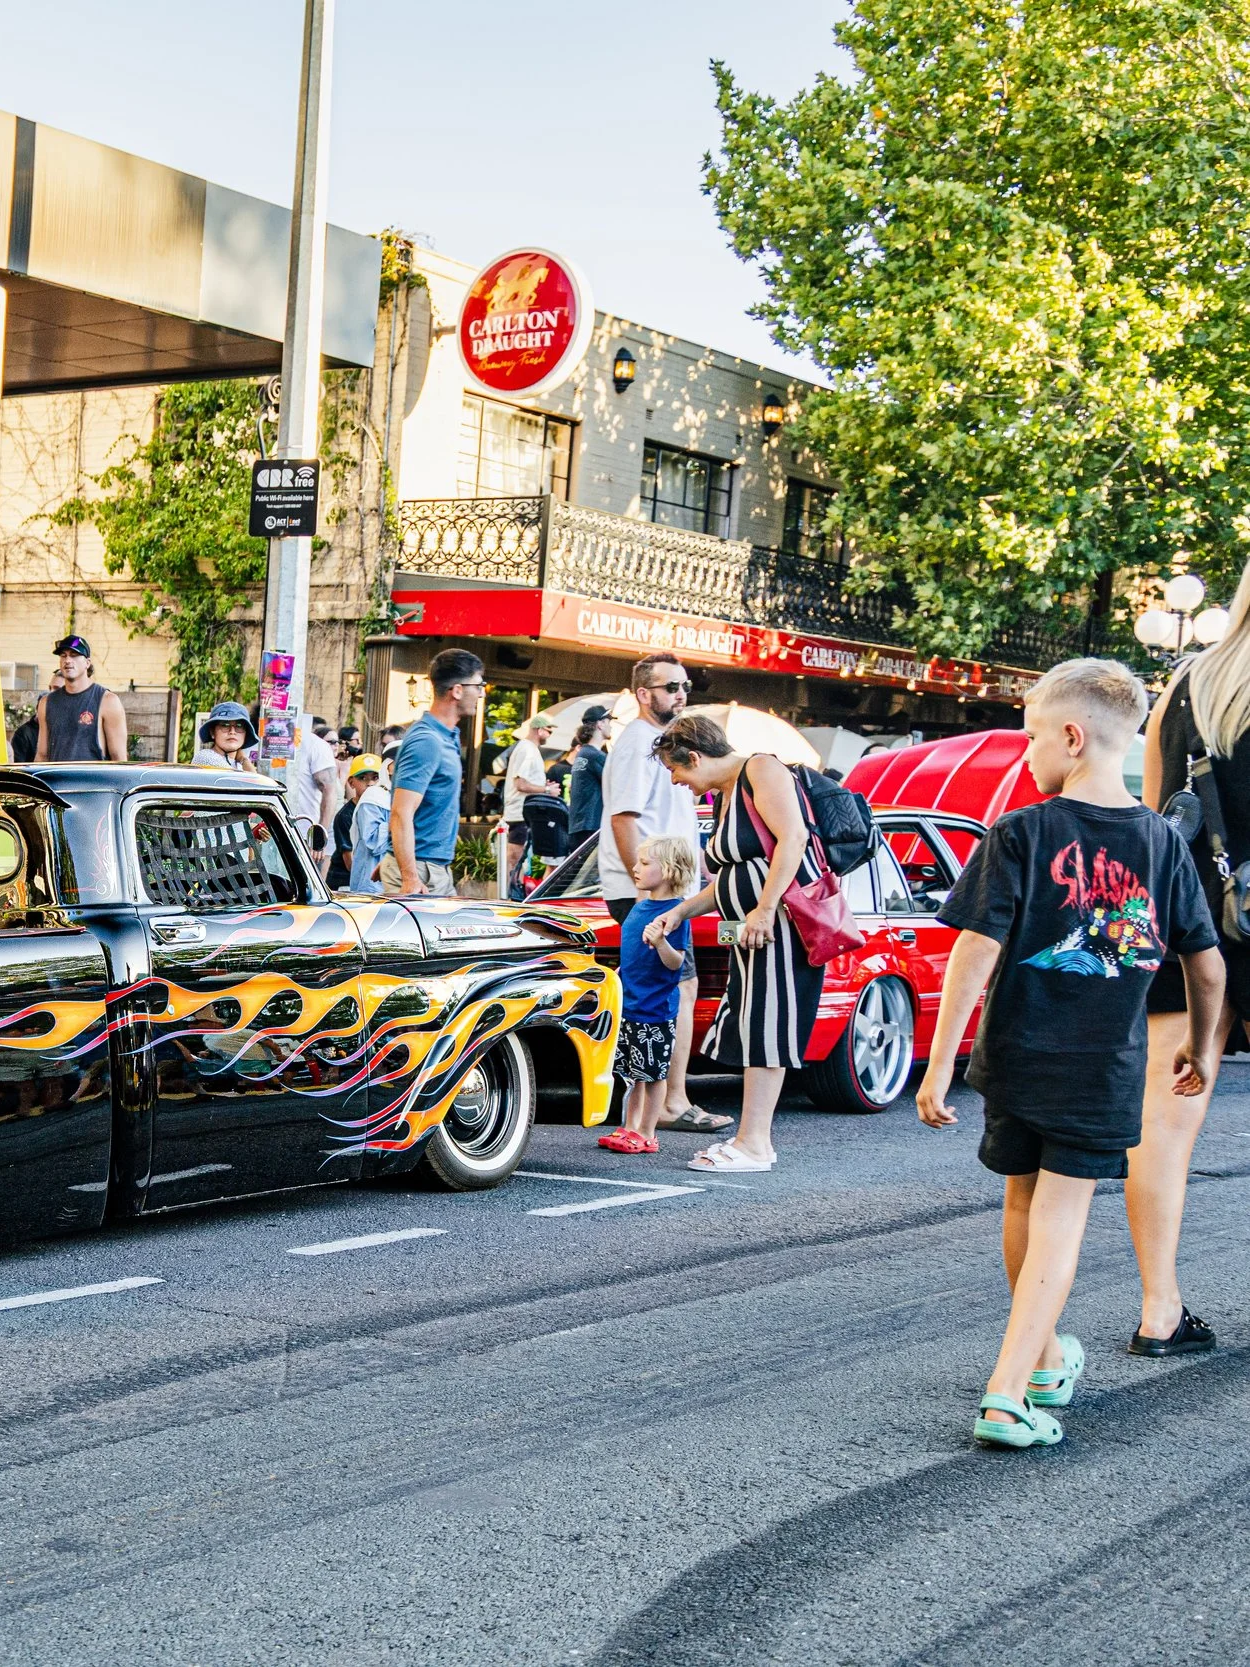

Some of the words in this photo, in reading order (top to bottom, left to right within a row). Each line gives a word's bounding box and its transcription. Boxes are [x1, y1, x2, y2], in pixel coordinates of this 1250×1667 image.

[469, 310, 560, 338] CARLTON
[472, 330, 555, 356] DRAUGHT
[518, 350, 546, 366] Fresh
[256, 468, 294, 488] CBR
[294, 475, 315, 488] free
[255, 494, 269, 502] Public
[577, 610, 651, 643] CARLTON
[675, 627, 746, 656] DRAUGHT
[802, 645, 859, 672] CARLTON
[877, 656, 931, 682] DRAUGHT
